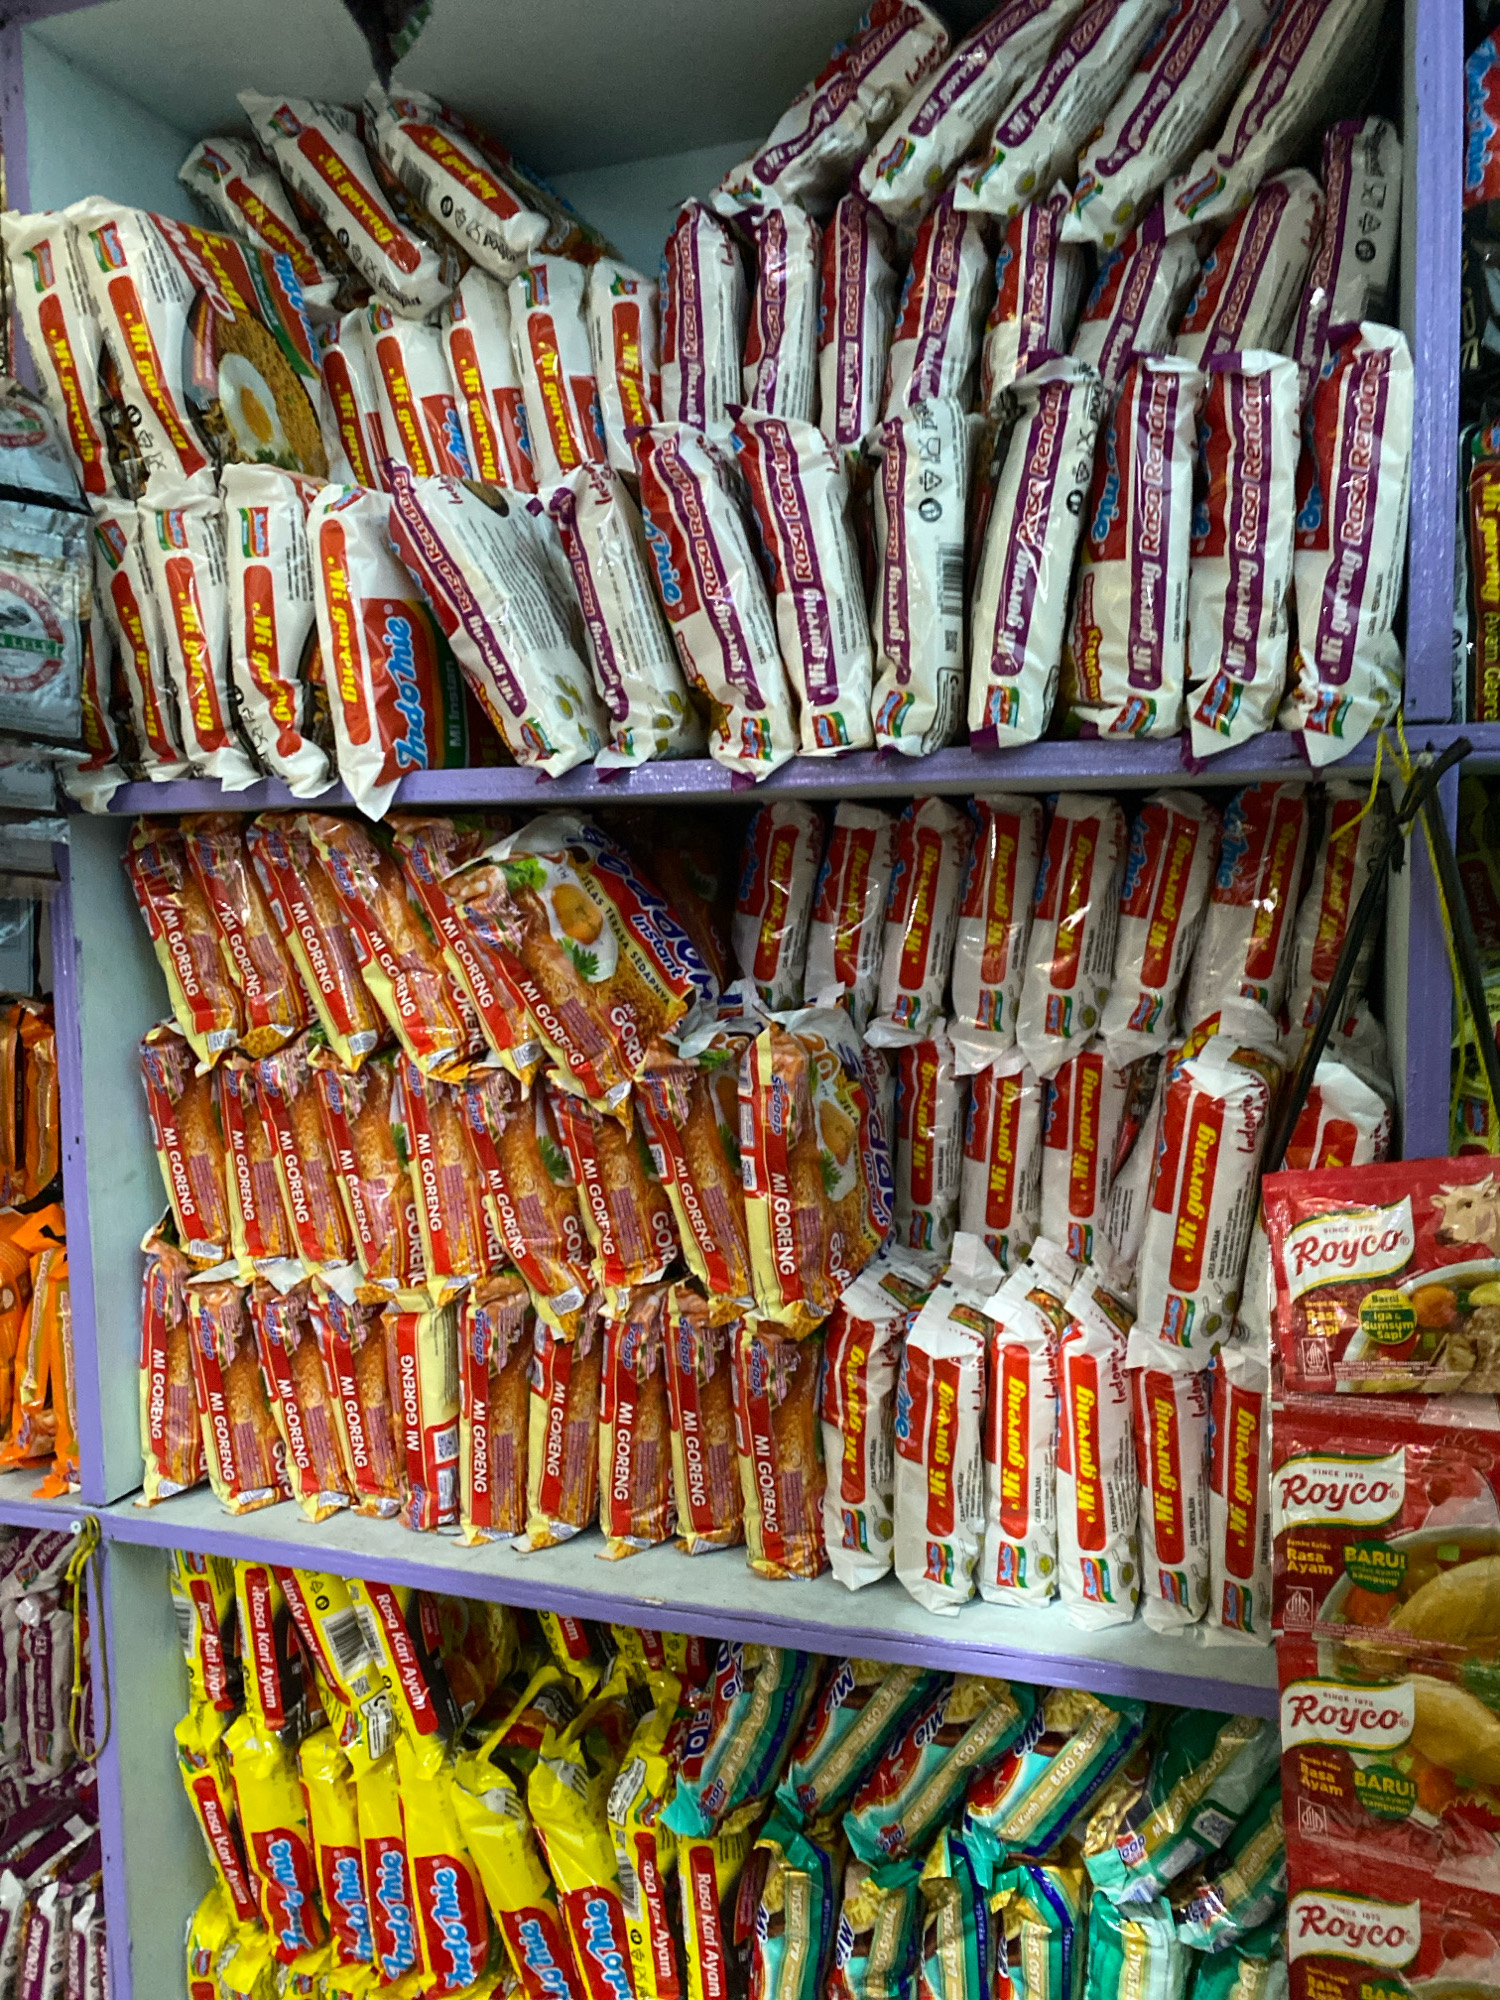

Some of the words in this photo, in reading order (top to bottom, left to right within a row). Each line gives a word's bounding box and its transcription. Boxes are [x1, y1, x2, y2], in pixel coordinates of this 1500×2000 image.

[844, 282, 861, 336] Rasa
[461, 366, 481, 394] Mi
[1346, 348, 1390, 473] Rendang
[661, 439, 706, 538] Rendang
[763, 421, 801, 521] Rendang
[393, 472, 443, 565] Rendang
[886, 494, 901, 560] Rasa
[1017, 479, 1050, 545] Rasa
[1138, 487, 1163, 557] Rasa
[1235, 481, 1260, 553] Rasa
[1339, 472, 1370, 546] Rasa
[696, 539, 723, 600] Rasa
[786, 519, 813, 583] Rasa
[437, 560, 472, 615] Rasa
[573, 560, 596, 618] Rasa
[1003, 548, 1034, 630] goreng
[1137, 560, 1163, 645] goreng
[1231, 558, 1260, 643] goreng
[1329, 550, 1364, 636] goreng
[331, 606, 358, 703] goreng
[802, 588, 830, 663] goreng
[1162, 834, 1192, 921] goreng
[581, 874, 604, 907] JELAS
[605, 907, 630, 950] TERASA
[167, 930, 199, 997] GORENG
[229, 933, 261, 997] GORENG
[291, 902, 308, 923] MI
[301, 925, 336, 993] GORENG
[368, 930, 386, 951] MI
[379, 952, 417, 1017] GORENG
[440, 917, 458, 939] MI
[453, 939, 495, 1009] GORENG
[630, 913, 686, 980] Instant
[520, 980, 541, 1003] MI
[535, 1003, 586, 1067] GORENG
[917, 1060, 937, 1140] goreng
[997, 1078, 1019, 1163] goreng
[1078, 1066, 1099, 1147] goreng
[162, 1126, 178, 1147] MI
[279, 1130, 295, 1151] MI
[339, 1149, 355, 1172] MI
[416, 1132, 431, 1156] MI
[169, 1150, 196, 1217] GORENG
[235, 1154, 256, 1222] GORENG
[284, 1154, 310, 1225] GORENG
[346, 1174, 372, 1244] GORENG
[420, 1159, 443, 1232] GORENG
[487, 1168, 504, 1191] MI
[496, 1192, 526, 1260] GORENG
[771, 1171, 789, 1194] MI
[1175, 1217, 1197, 1249] Mi
[1186, 1121, 1218, 1219] goreng
[587, 1183, 615, 1256] GORENG
[680, 1182, 716, 1254] GORENG
[774, 1196, 796, 1276] GORENG
[1291, 1229, 1403, 1276] Royco
[152, 1348, 165, 1370] MI
[277, 1379, 292, 1399] MI
[340, 1376, 356, 1397] MI
[401, 1354, 419, 1427] GORENG
[847, 1344, 866, 1433] goreng
[150, 1373, 166, 1440] GORENG
[209, 1392, 225, 1412] MI
[472, 1399, 487, 1422] MI
[553, 1381, 567, 1404] MI
[618, 1401, 635, 1426] MI
[682, 1409, 698, 1434] MI
[934, 1380, 955, 1465] goreng
[1006, 1375, 1027, 1467] goreng
[212, 1414, 235, 1482] GORENG
[284, 1401, 310, 1470] GORENG
[344, 1399, 368, 1468] GORENG
[406, 1429, 420, 1452] MI
[472, 1424, 488, 1494] GORENG
[546, 1406, 566, 1478] GORENG
[613, 1428, 632, 1501] GORENG
[755, 1434, 770, 1458] MI
[1076, 1384, 1097, 1480] goreng
[1154, 1396, 1177, 1491] goreng
[1234, 1406, 1256, 1504] goreng
[682, 1436, 707, 1507] GORENG
[757, 1459, 780, 1533] GORENG
[1002, 1467, 1021, 1498] Mi
[1076, 1481, 1096, 1516] Mi
[1279, 1474, 1393, 1512] Royco
[1154, 1492, 1175, 1527] Mi
[1229, 1502, 1249, 1540] Mi
[1287, 1547, 1325, 1563] Rasa
[1287, 1561, 1334, 1575] Ayam
[1344, 1546, 1406, 1569] BARU!
[251, 1585, 267, 1629] Rasa
[282, 1578, 306, 1620] Ayam
[376, 1593, 398, 1629] Rasa
[257, 1631, 271, 1664] Kari
[392, 1632, 413, 1666] Kari
[260, 1666, 277, 1709] Ayam
[402, 1667, 427, 1711] Ayam
[1287, 1694, 1402, 1735] Royco
[1049, 1758, 1077, 1787] BASO
[1300, 1761, 1336, 1783] Rasa
[1301, 1775, 1343, 1797] Ayam
[1354, 1770, 1416, 1798] BARU!
[203, 1801, 220, 1835] Rasa
[697, 1872, 712, 1911] Rasa
[653, 1928, 671, 1977] Ayam
[702, 1911, 717, 1947] Kari
[1296, 1905, 1412, 1948] Royco
[703, 1948, 720, 1997] Ayam
